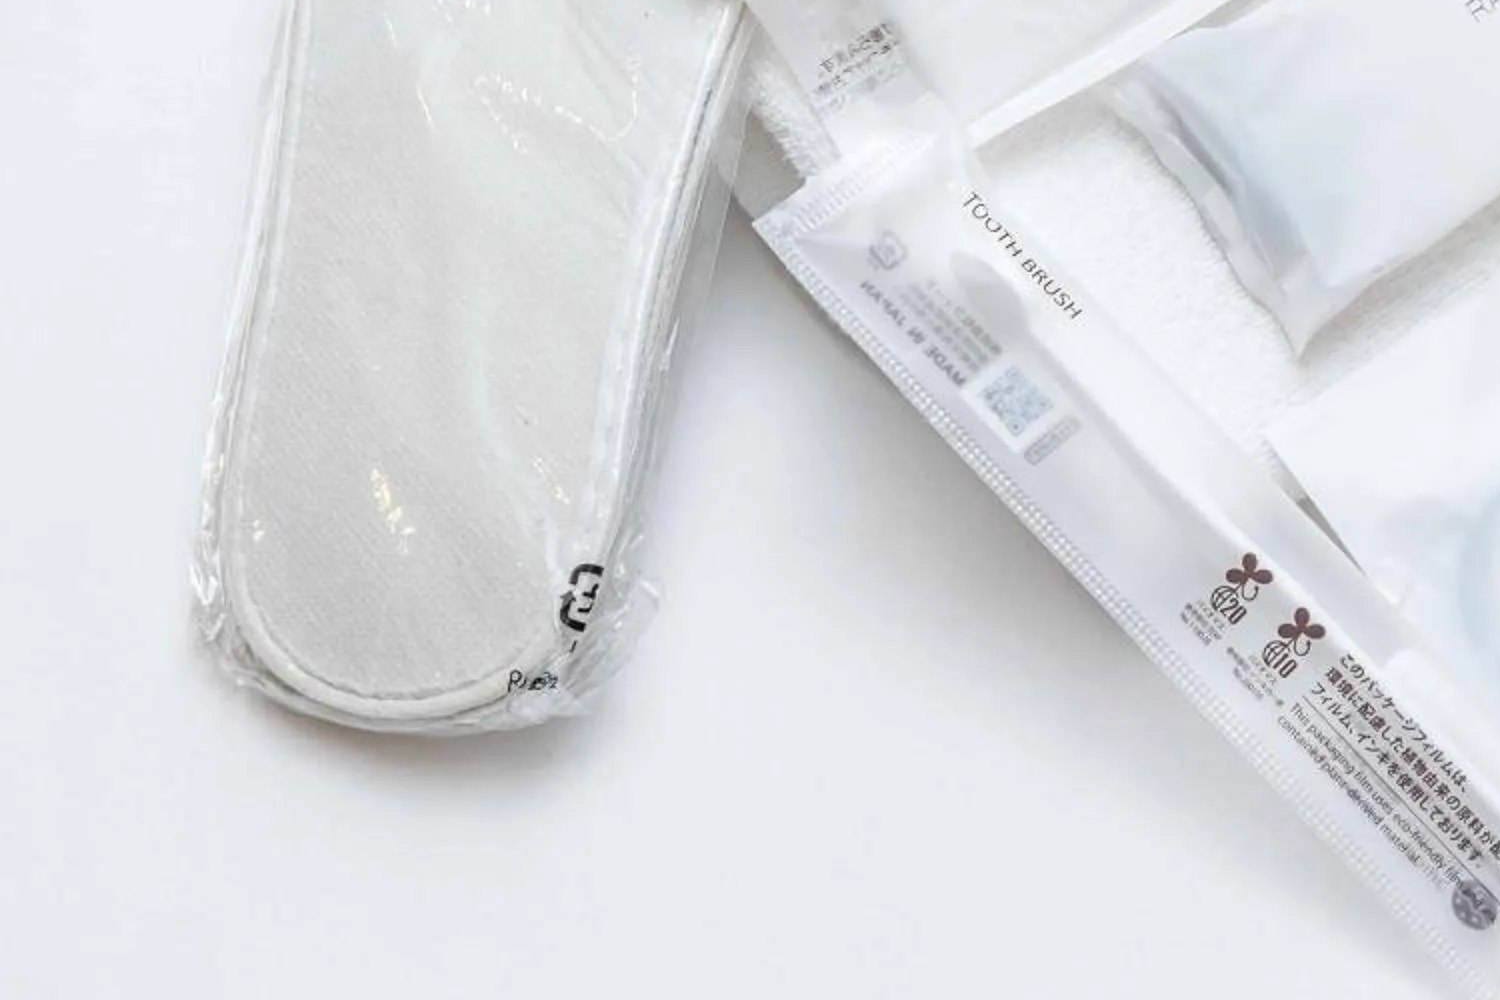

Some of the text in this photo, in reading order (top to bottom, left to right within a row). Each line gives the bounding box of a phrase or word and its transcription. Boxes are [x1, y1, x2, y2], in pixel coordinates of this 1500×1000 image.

[963, 191, 1083, 319] TOOTH BRUSH
[1219, 597, 1248, 625] 20
[1272, 653, 1298, 679] 10
